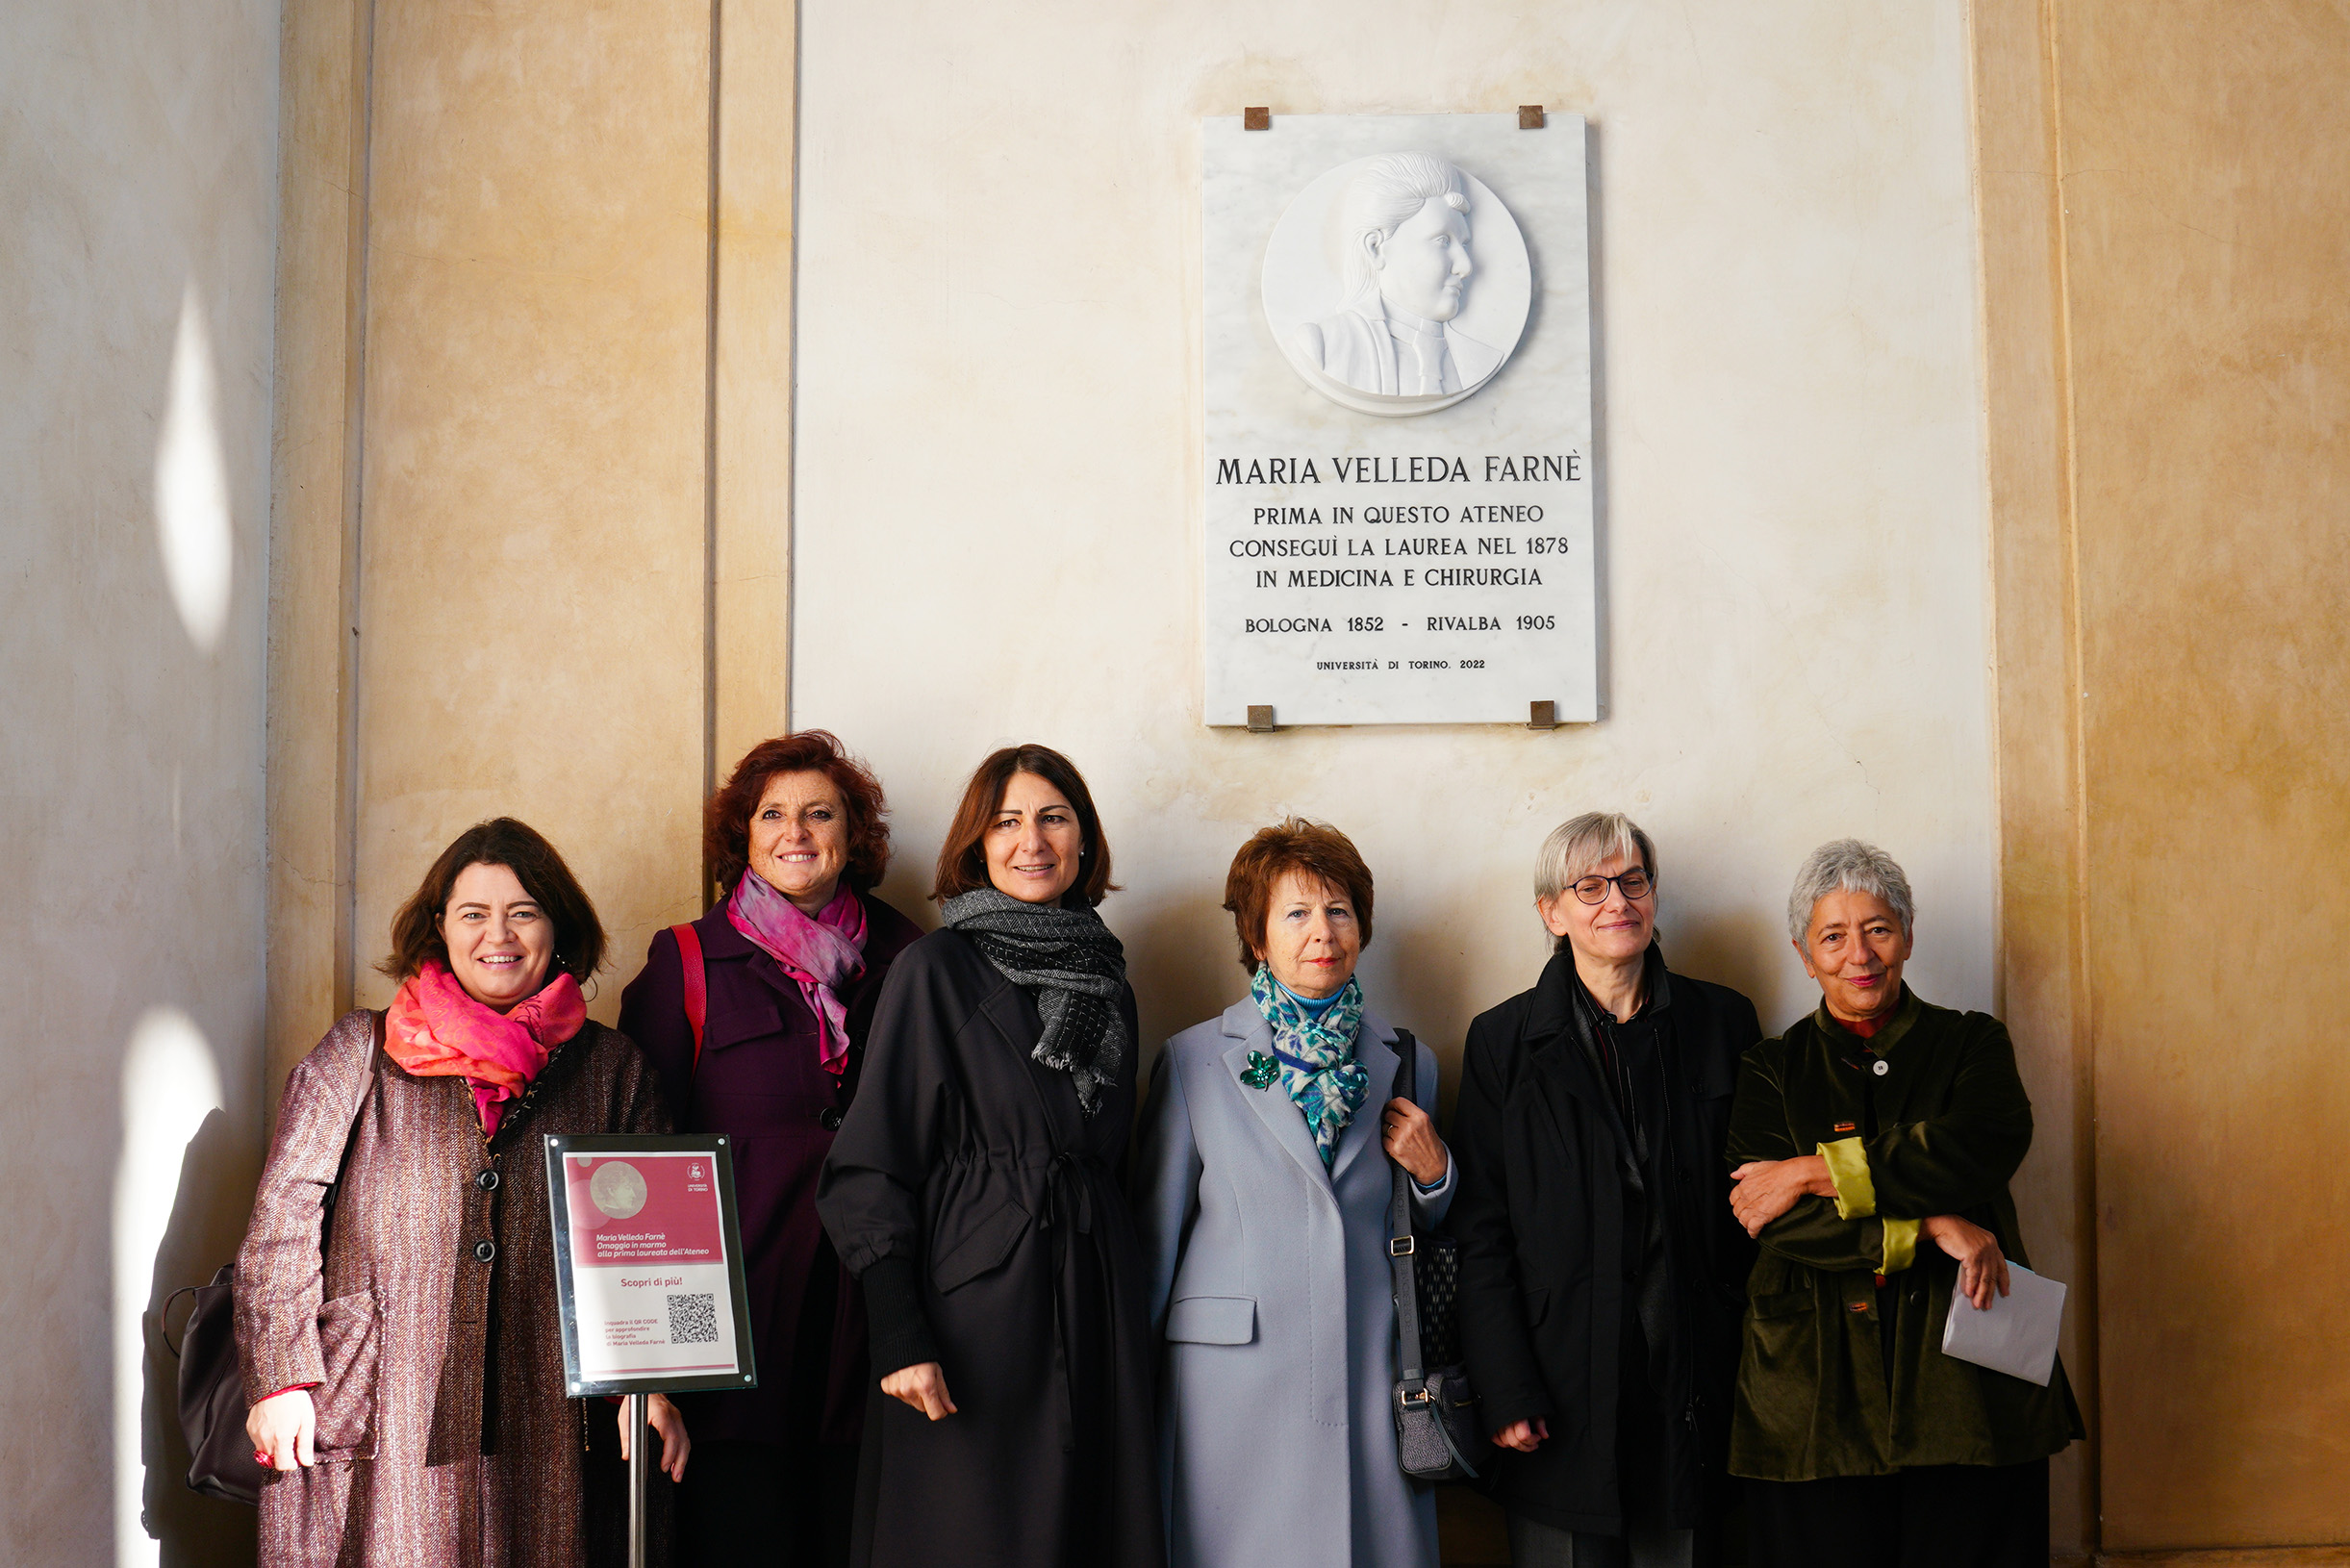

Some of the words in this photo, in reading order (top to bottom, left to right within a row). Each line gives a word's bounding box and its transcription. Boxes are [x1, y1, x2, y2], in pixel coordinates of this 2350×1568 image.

[1215, 457, 1322, 485] MARIA
[1331, 456, 1471, 484] VELLEDA
[1484, 448, 1581, 482] FARNÈ
[1253, 507, 1323, 525] PRIMA
[1332, 506, 1354, 524] IN
[1363, 505, 1451, 524] QUESTO
[1459, 504, 1544, 523] ATENEO
[1229, 534, 1338, 558] CONSEGUÌ
[1348, 539, 1376, 556] LA
[1384, 538, 1468, 556] LAUREA
[1478, 537, 1517, 555] NEL
[1526, 537, 1569, 555] 1878
[1256, 569, 1277, 588] IN
[1287, 569, 1394, 588] MEDICINA
[1403, 569, 1415, 587] E
[1424, 568, 1543, 587] CHIRURGIA
[1245, 618, 1333, 633] BOLOGNA
[1347, 616, 1384, 632] 1852
[1427, 616, 1502, 631] RIVALBA
[1516, 615, 1555, 631] 1905
[1316, 658, 1379, 670] UNIVERSITÀ
[1388, 660, 1400, 670] DI
[1459, 659, 1485, 670] 2022
[595, 1233, 617, 1242] Maria
[596, 1242, 630, 1251] Omaggio
[613, 1250, 635, 1258] prima
[620, 1277, 651, 1288] Scopri
[653, 1277, 663, 1286] di
[665, 1277, 683, 1287] più!
